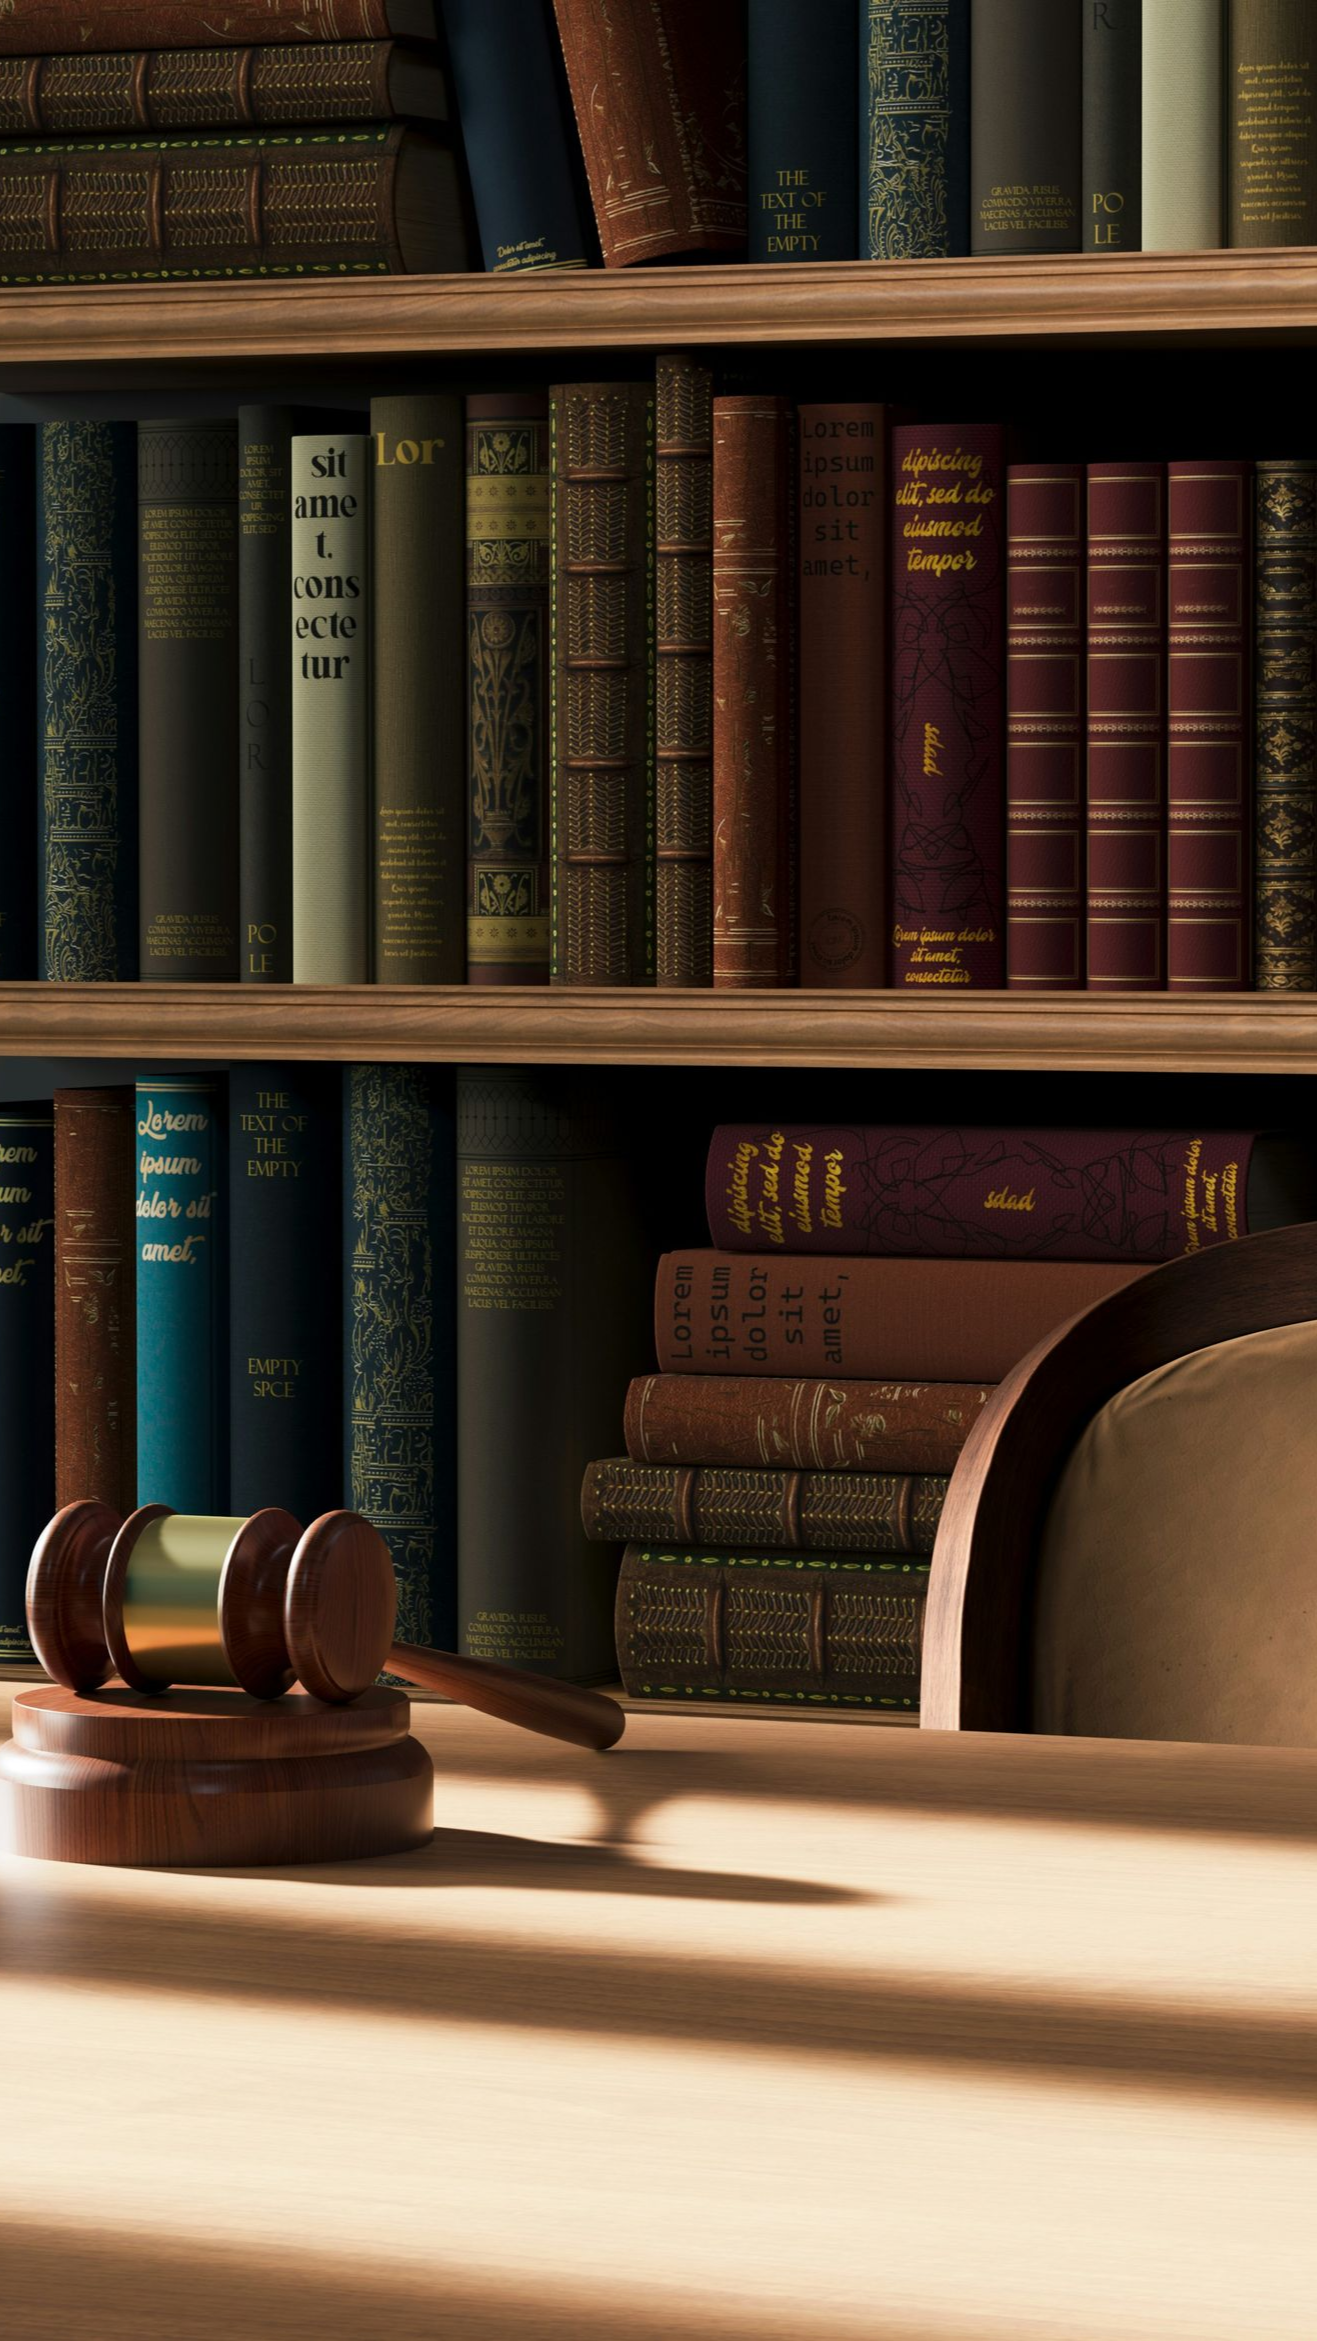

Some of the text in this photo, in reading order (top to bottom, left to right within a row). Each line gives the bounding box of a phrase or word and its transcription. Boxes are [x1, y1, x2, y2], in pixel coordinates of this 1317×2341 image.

[1093, 1, 1118, 30] R
[776, 169, 810, 187] THE
[759, 191, 828, 209] TEXT OF
[1092, 192, 1125, 214] PO
[773, 213, 808, 230] THE
[1094, 223, 1122, 245] LE
[767, 234, 822, 252] EMPTY
[803, 418, 875, 438] Lorem
[311, 447, 347, 478] sit
[376, 432, 445, 466] Lor
[803, 451, 875, 478] ipsum
[901, 447, 983, 479] dipiscing
[295, 495, 357, 519] ame
[803, 485, 875, 508] dolor
[895, 480, 996, 508] elit, sed do
[815, 519, 860, 541] sit
[903, 513, 984, 538] eiusmod
[315, 531, 333, 559] t.
[803, 554, 870, 581] amet,
[907, 546, 978, 578] tempor
[294, 575, 360, 599] cons
[296, 611, 357, 639] ecte
[301, 653, 350, 679] tur
[922, 722, 947, 777] sdad
[247, 923, 277, 945] PO
[891, 924, 997, 948] Lorem ipsum dolor
[249, 953, 275, 973] LE
[910, 946, 964, 965] sit amet,
[904, 967, 973, 984] consectetur
[256, 1092, 291, 1109] THE
[138, 1100, 208, 1141] Lorem
[240, 1114, 309, 1132] TEXT OF
[253, 1137, 288, 1154] THE
[1183, 1138, 1203, 1176] dolor
[139, 1151, 202, 1184] ipsum
[247, 1160, 302, 1177] EMPTY
[465, 1165, 559, 1177] LOREM IPSUM DOLOR
[726, 1141, 759, 1234] dipiscing
[757, 1130, 786, 1244] elit, sed do
[788, 1142, 814, 1233] eiusmod
[818, 1148, 848, 1228] tempor
[983, 1184, 1037, 1211] sdad
[1180, 1177, 1199, 1219] ipsum
[1201, 1169, 1218, 1232] sit amet,
[1221, 1161, 1238, 1240] consectetur
[136, 1191, 219, 1219] dolor sit
[16, 1218, 54, 1244] sit
[141, 1235, 206, 1265] amet,
[671, 1265, 694, 1359] Lorem
[706, 1266, 735, 1359] ipsum
[741, 1266, 768, 1361] dolor
[778, 1286, 803, 1344] sit
[818, 1274, 849, 1364] amet,
[248, 1358, 303, 1375] EMPTY
[253, 1380, 296, 1398] SPCE
